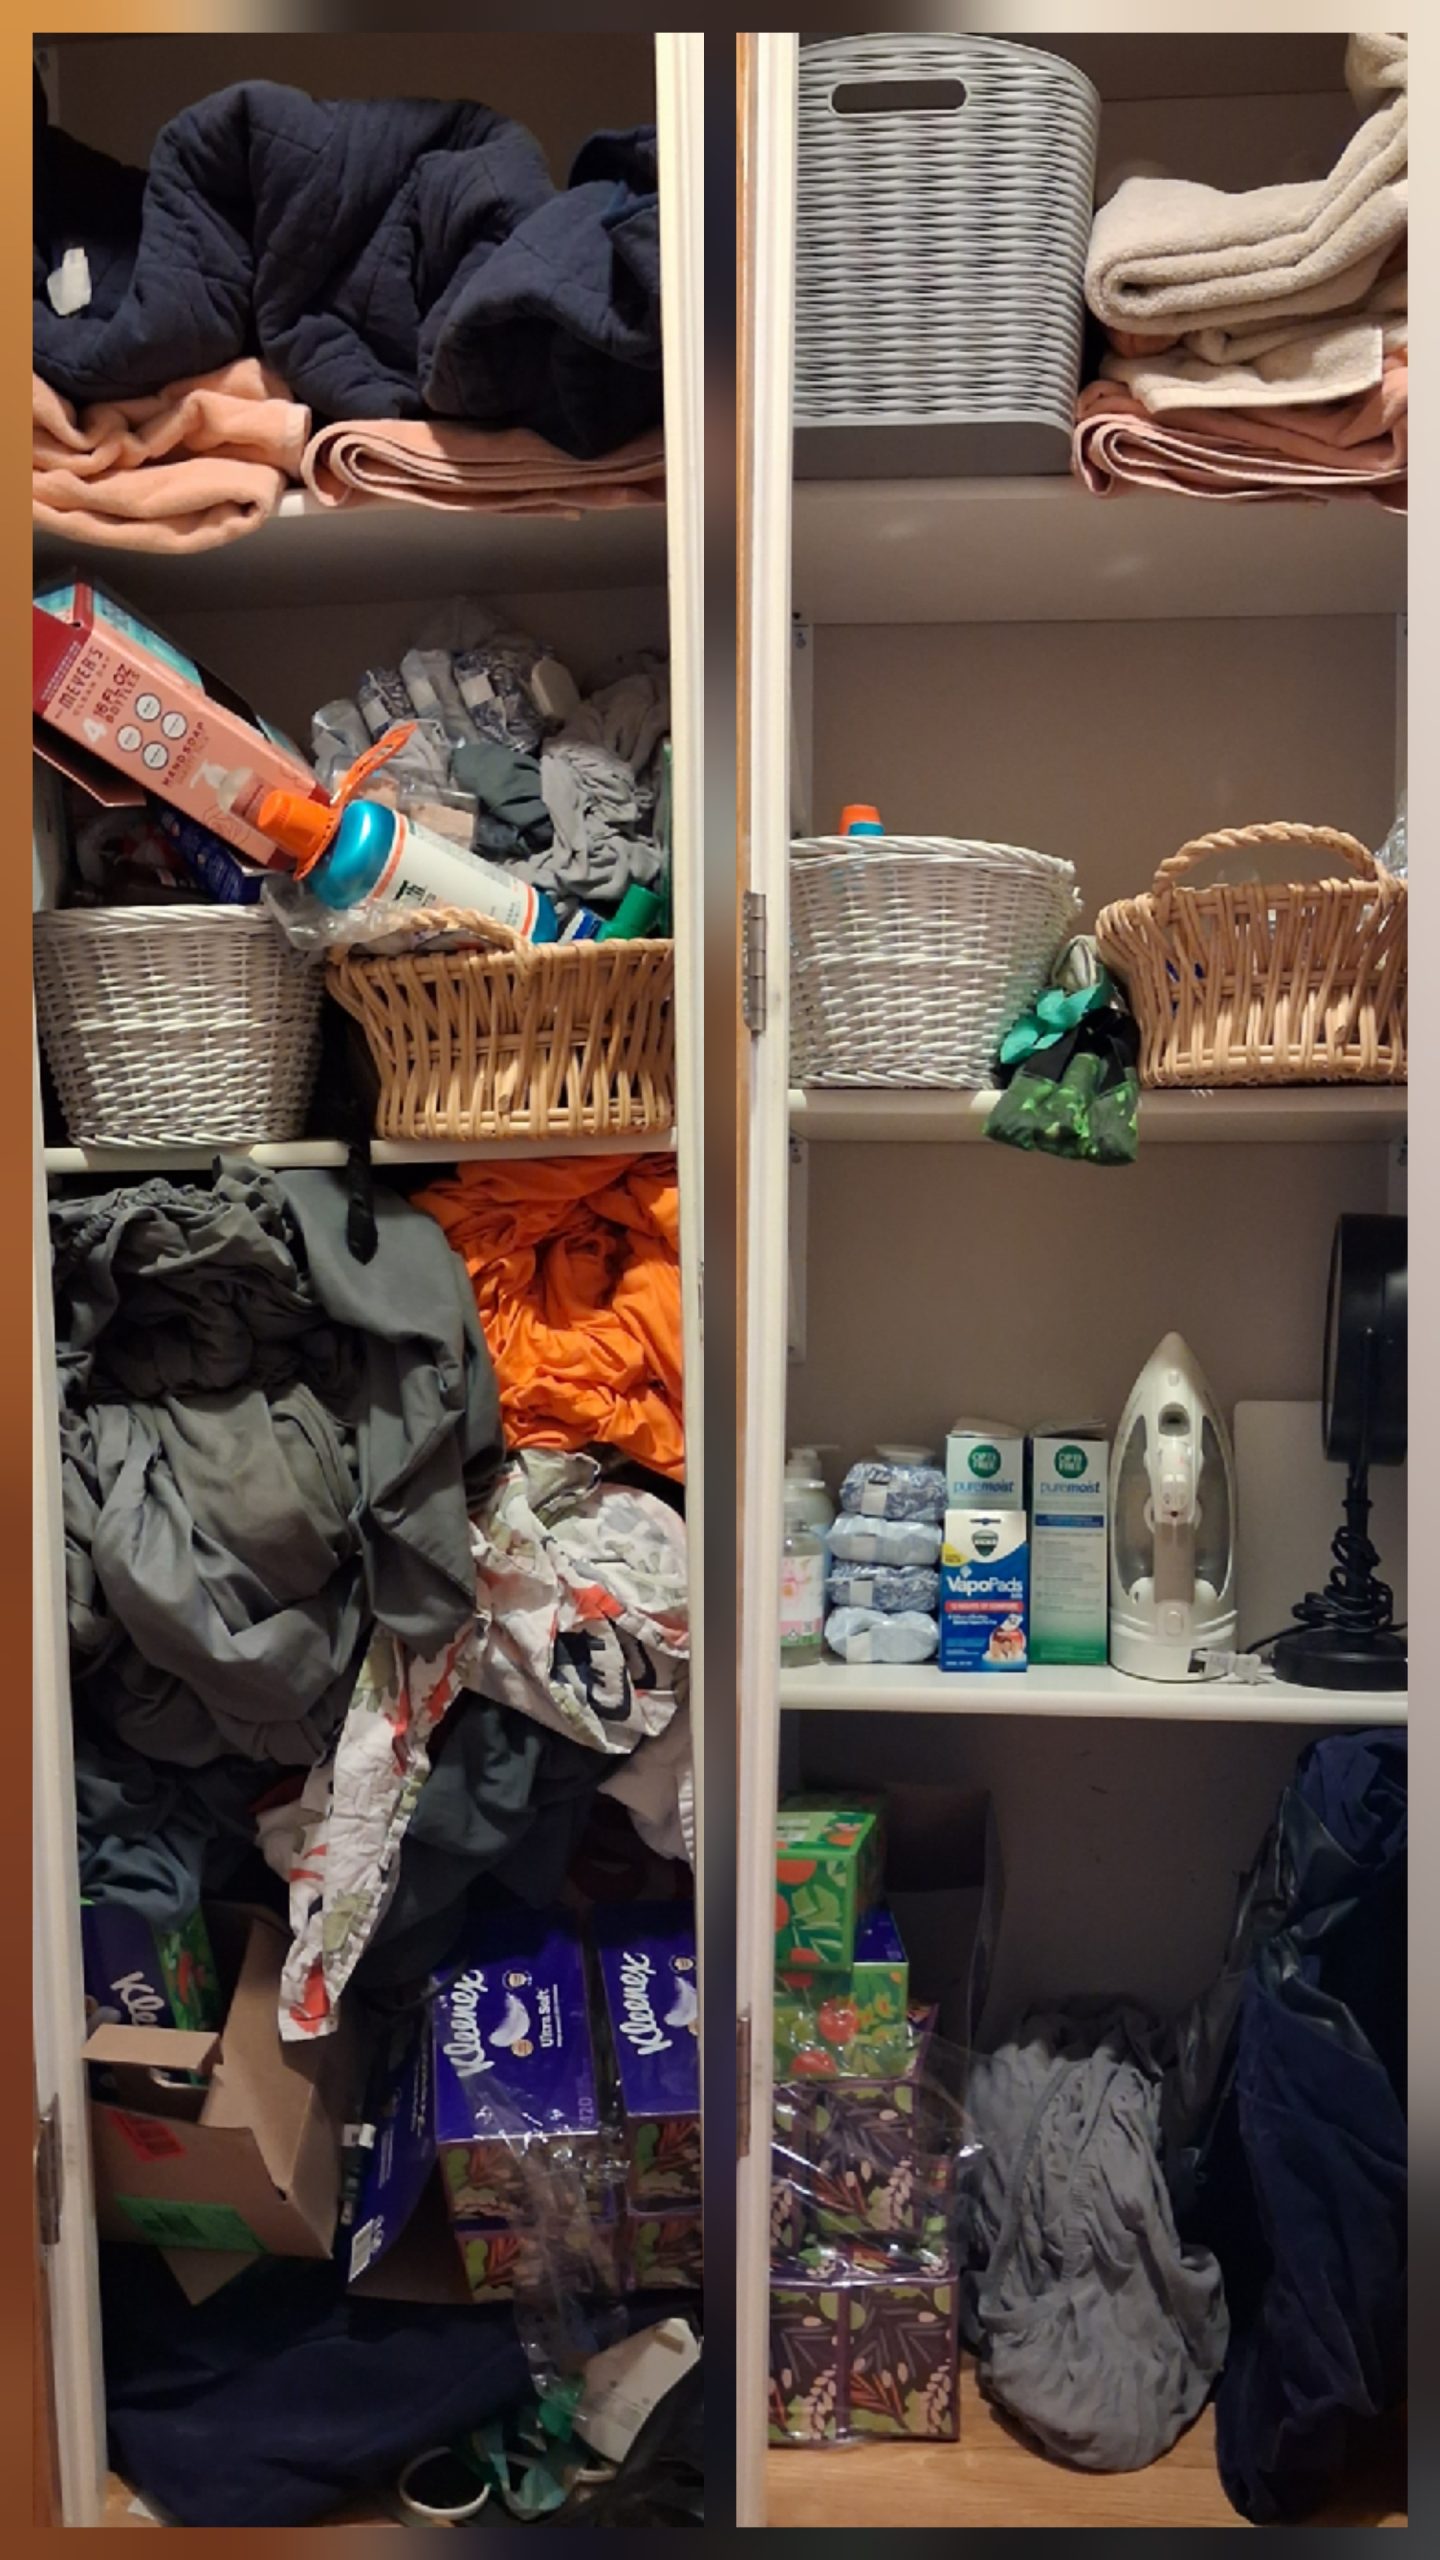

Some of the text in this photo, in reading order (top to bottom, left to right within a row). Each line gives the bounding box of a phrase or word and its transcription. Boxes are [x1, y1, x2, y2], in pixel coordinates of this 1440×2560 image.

[112, 663, 133, 686] OZ
[82, 717, 107, 743] 4
[953, 1479, 1015, 1494] puremoist
[1040, 1480, 1100, 1494] puremoist
[946, 1575, 1023, 1597] VapoPads
[619, 1951, 672, 2055] Kleenex
[443, 1969, 495, 2077] Kleenex
[535, 1988, 554, 2048] Ultra Soft
